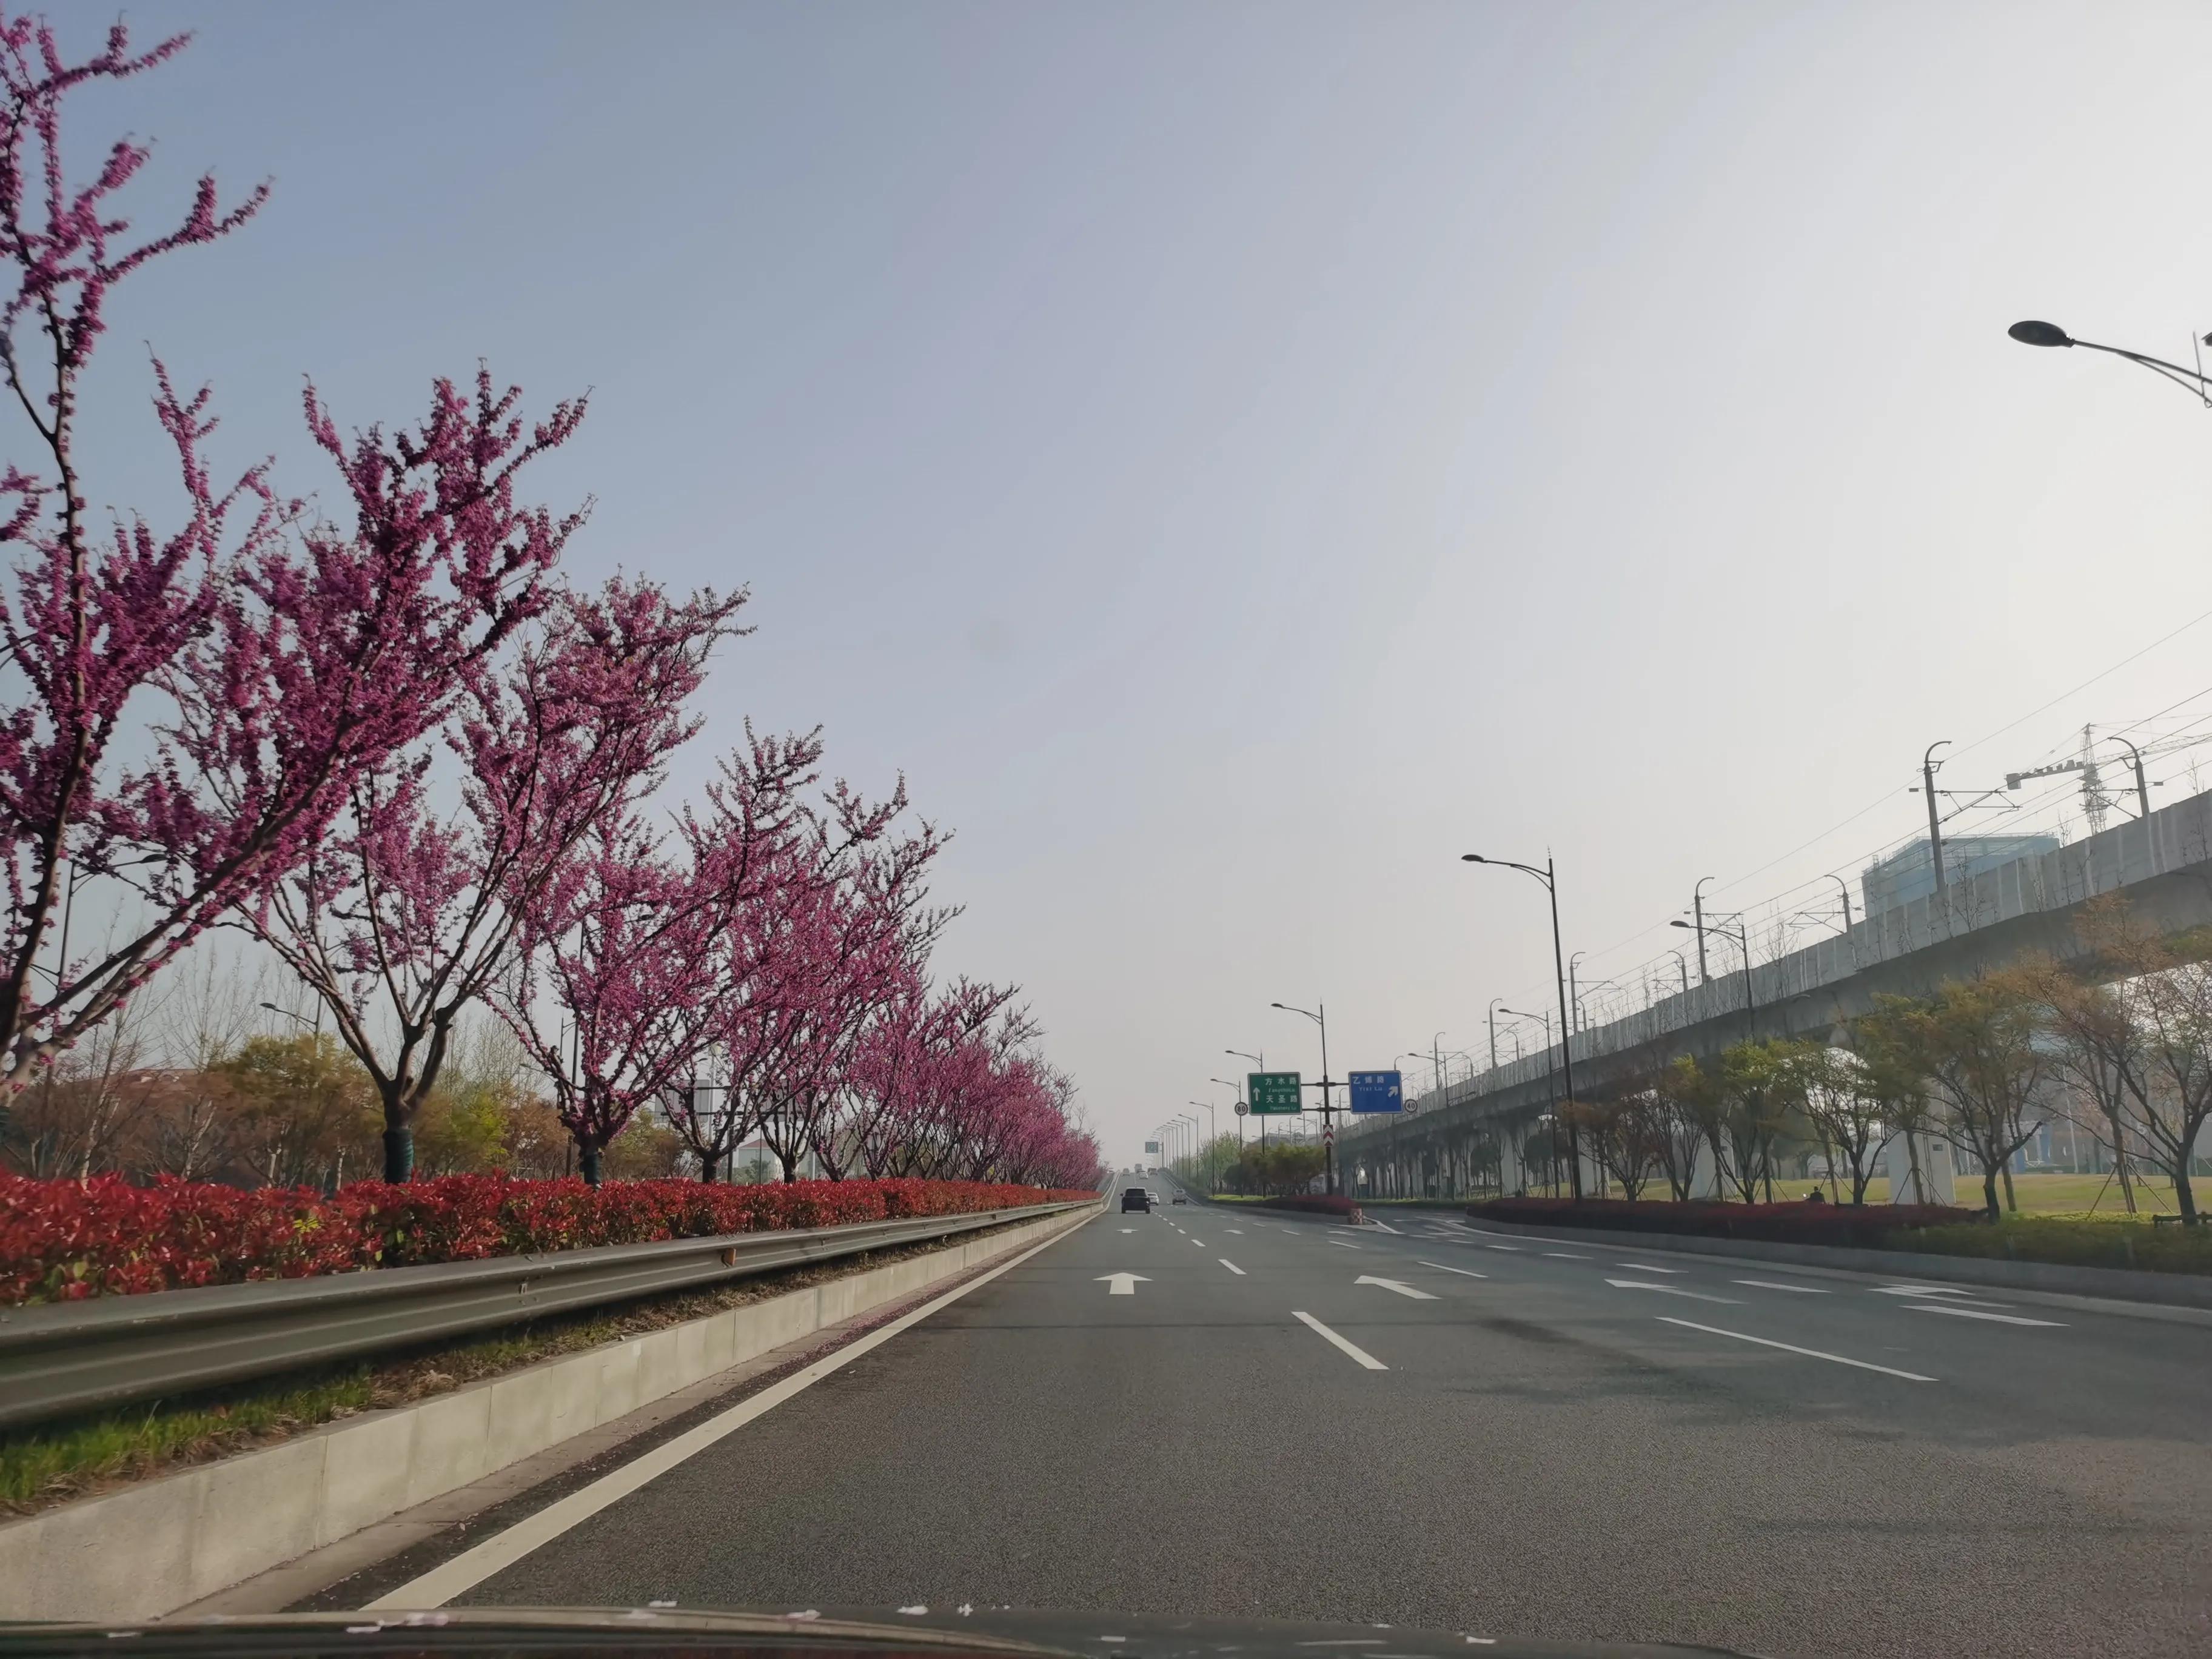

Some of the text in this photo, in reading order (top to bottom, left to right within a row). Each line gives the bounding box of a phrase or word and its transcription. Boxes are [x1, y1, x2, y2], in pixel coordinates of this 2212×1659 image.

[1265, 1077, 1296, 1085] 方水路
[1265, 1094, 1298, 1103] 天圣路
